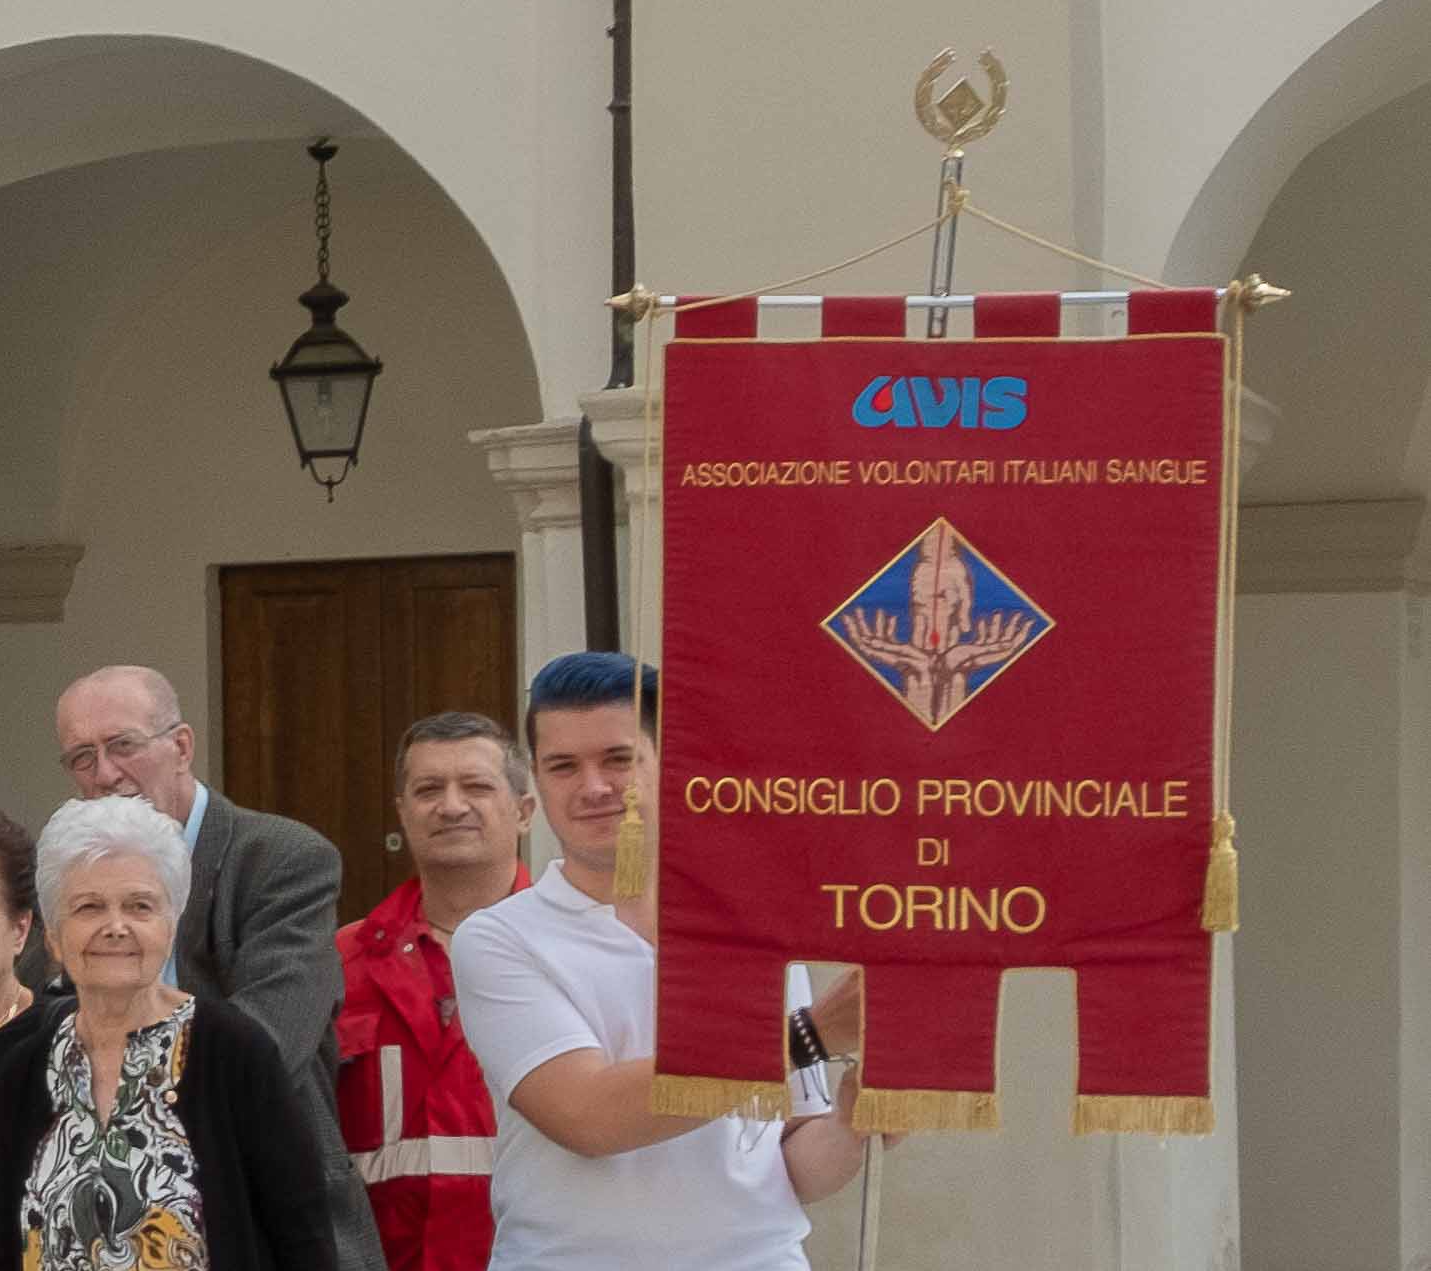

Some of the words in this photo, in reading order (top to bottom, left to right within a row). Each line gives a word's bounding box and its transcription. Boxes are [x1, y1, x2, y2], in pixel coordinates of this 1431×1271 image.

[681, 460, 850, 487] ASSOCIAZIONE
[859, 461, 994, 484] VOLONTARI
[1003, 461, 1098, 485] ITALIANI
[1106, 459, 1207, 485] SANGUE
[684, 776, 901, 815] CONSIGLIO
[917, 778, 1188, 817] PROVINCIALE
[917, 838, 949, 866] DI
[821, 884, 1046, 933] TORINO
